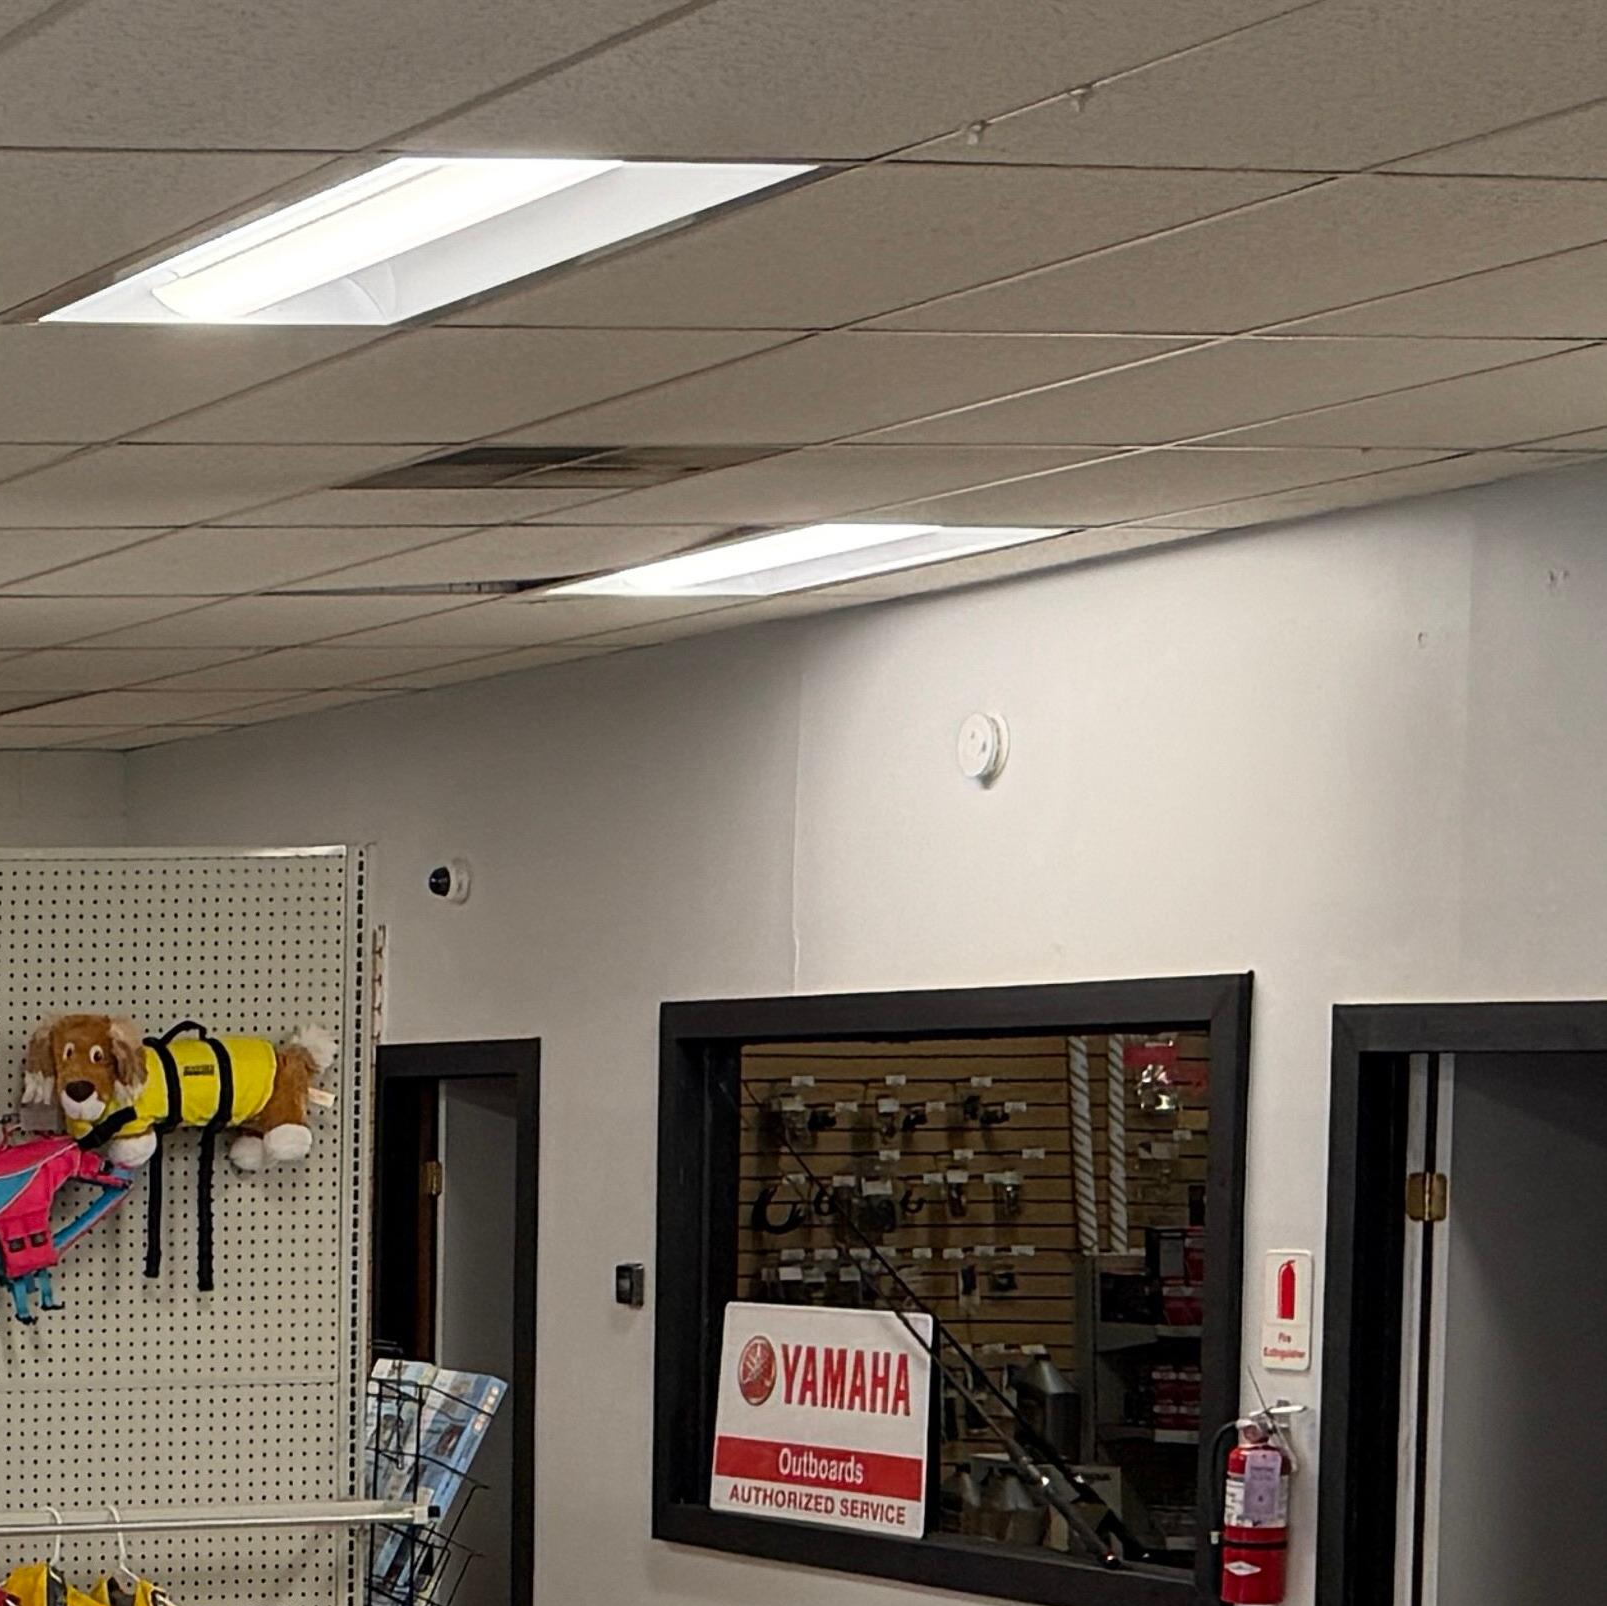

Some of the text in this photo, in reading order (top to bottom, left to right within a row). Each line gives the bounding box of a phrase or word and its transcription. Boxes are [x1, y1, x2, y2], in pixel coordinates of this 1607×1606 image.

[781, 1344, 911, 1417] YAMAHA
[778, 1447, 864, 1484] Outboards
[729, 1485, 906, 1525] AUTHORIZED SERVICE
